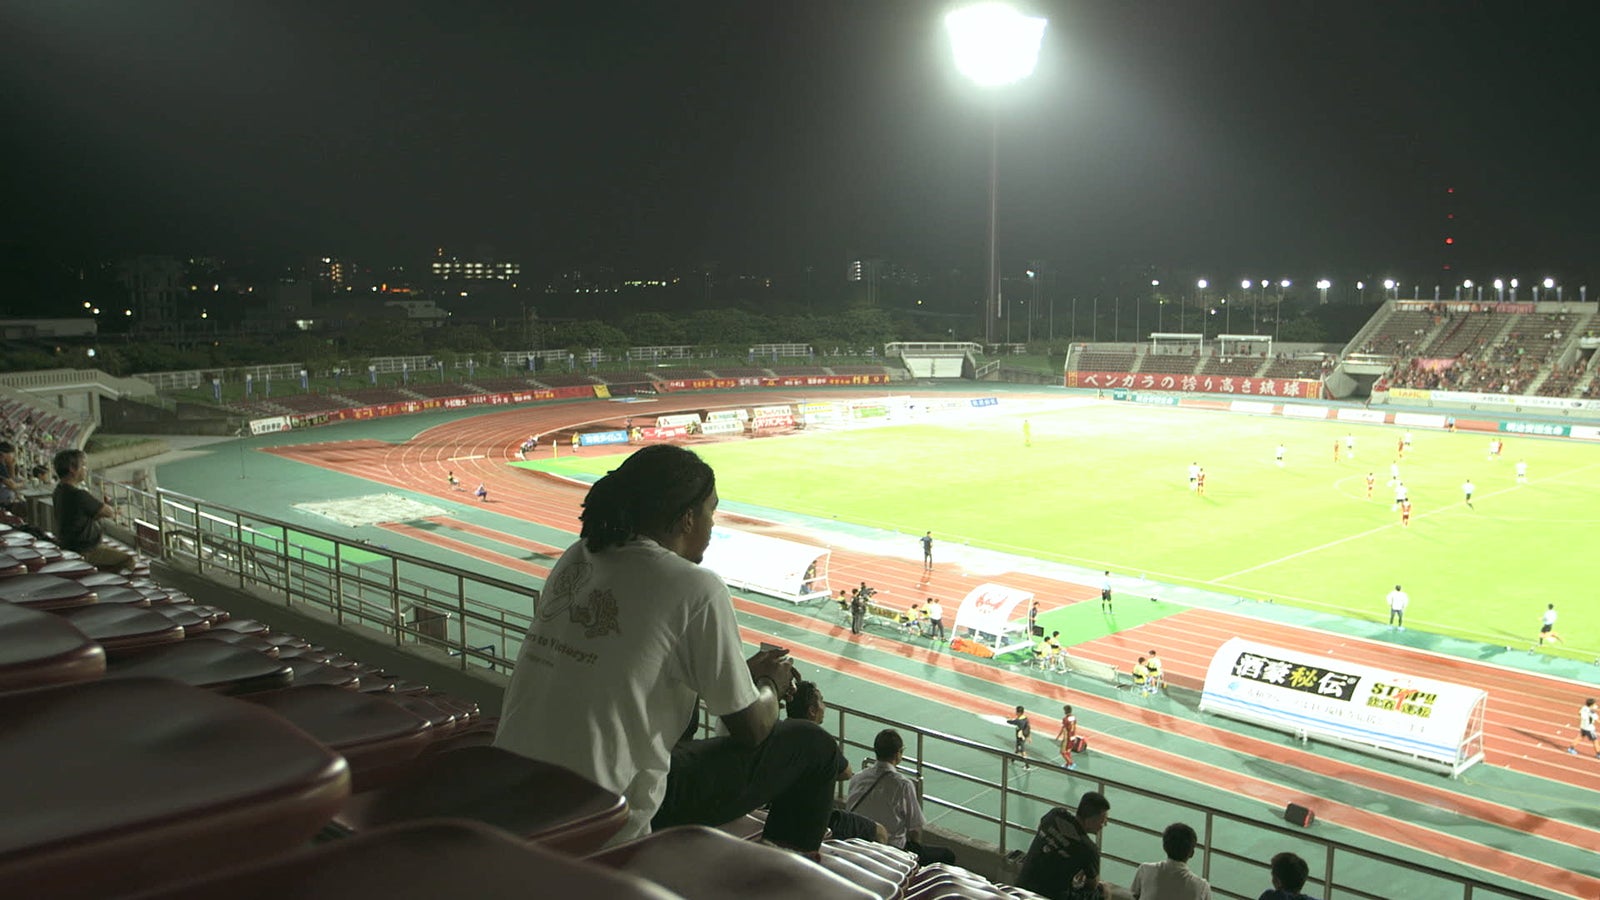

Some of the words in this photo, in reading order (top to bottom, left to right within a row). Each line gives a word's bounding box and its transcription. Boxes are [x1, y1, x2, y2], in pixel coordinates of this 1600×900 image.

[1084, 374, 1300, 397] ベンガラの誇り高き琉球
[1235, 654, 1349, 697] 酒豪秘伝
